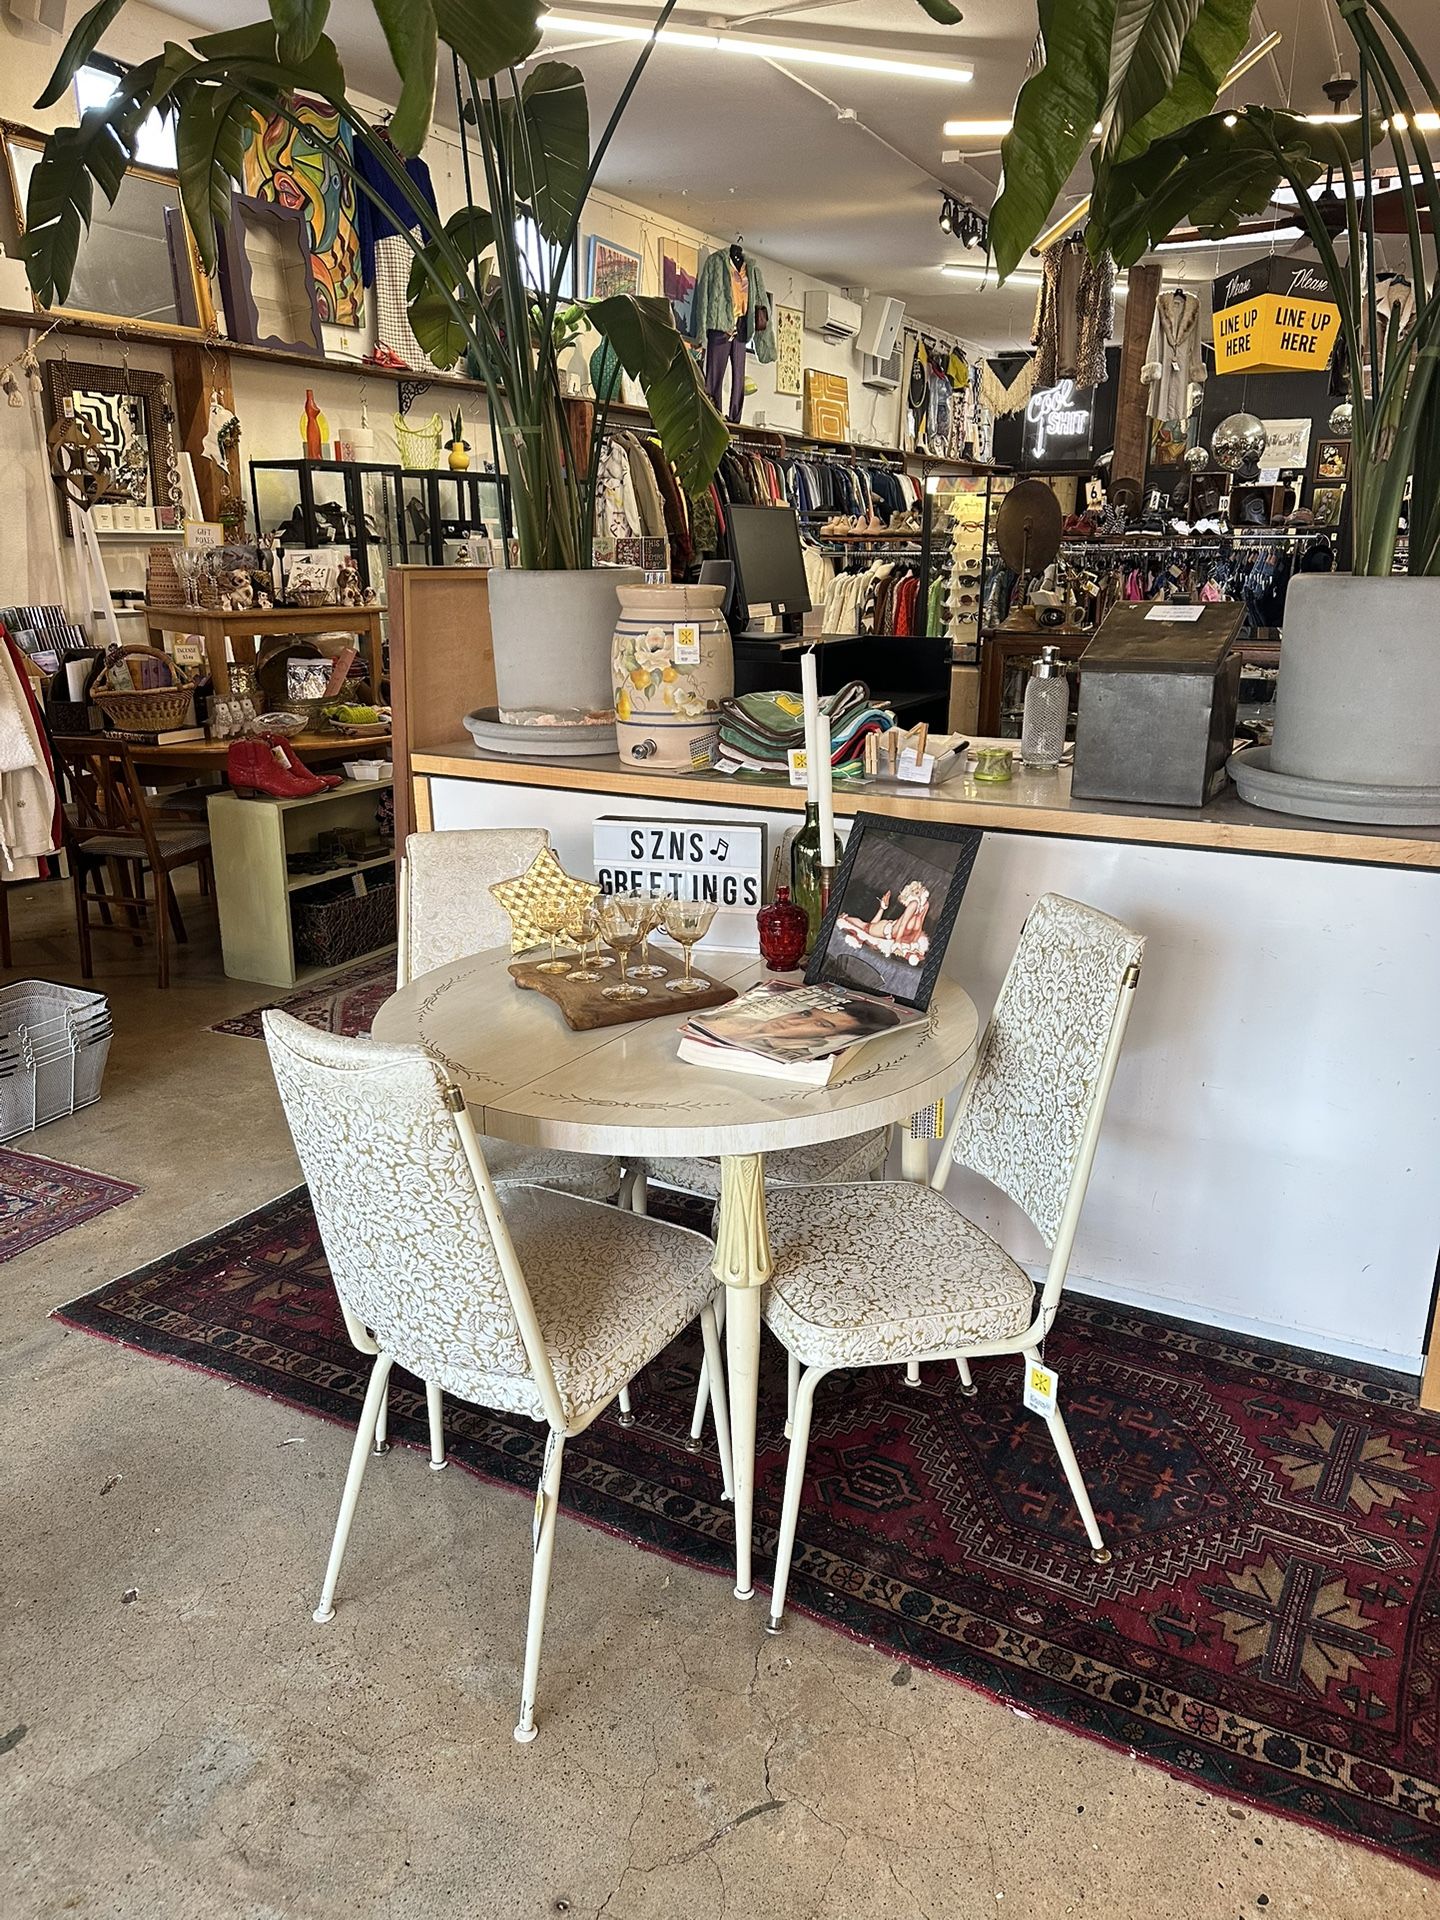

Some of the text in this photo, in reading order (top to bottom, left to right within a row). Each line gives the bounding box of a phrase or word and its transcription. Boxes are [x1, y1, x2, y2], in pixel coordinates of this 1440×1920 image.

[1224, 275, 1252, 309] Please
[1286, 268, 1328, 297] Please
[1220, 309, 1258, 336] LINE UP
[1275, 307, 1331, 331] LINE UP
[1226, 333, 1251, 357] HERE
[1280, 332, 1318, 353] HERE
[1027, 378, 1075, 422] Cool
[1046, 410, 1089, 435] SHIT
[1090, 485, 1098, 499] 6
[1220, 498, 1229, 509] 10
[197, 528, 211, 536] GIFT
[630, 830, 703, 862] SZNS
[599, 868, 757, 906] GREETINGS
